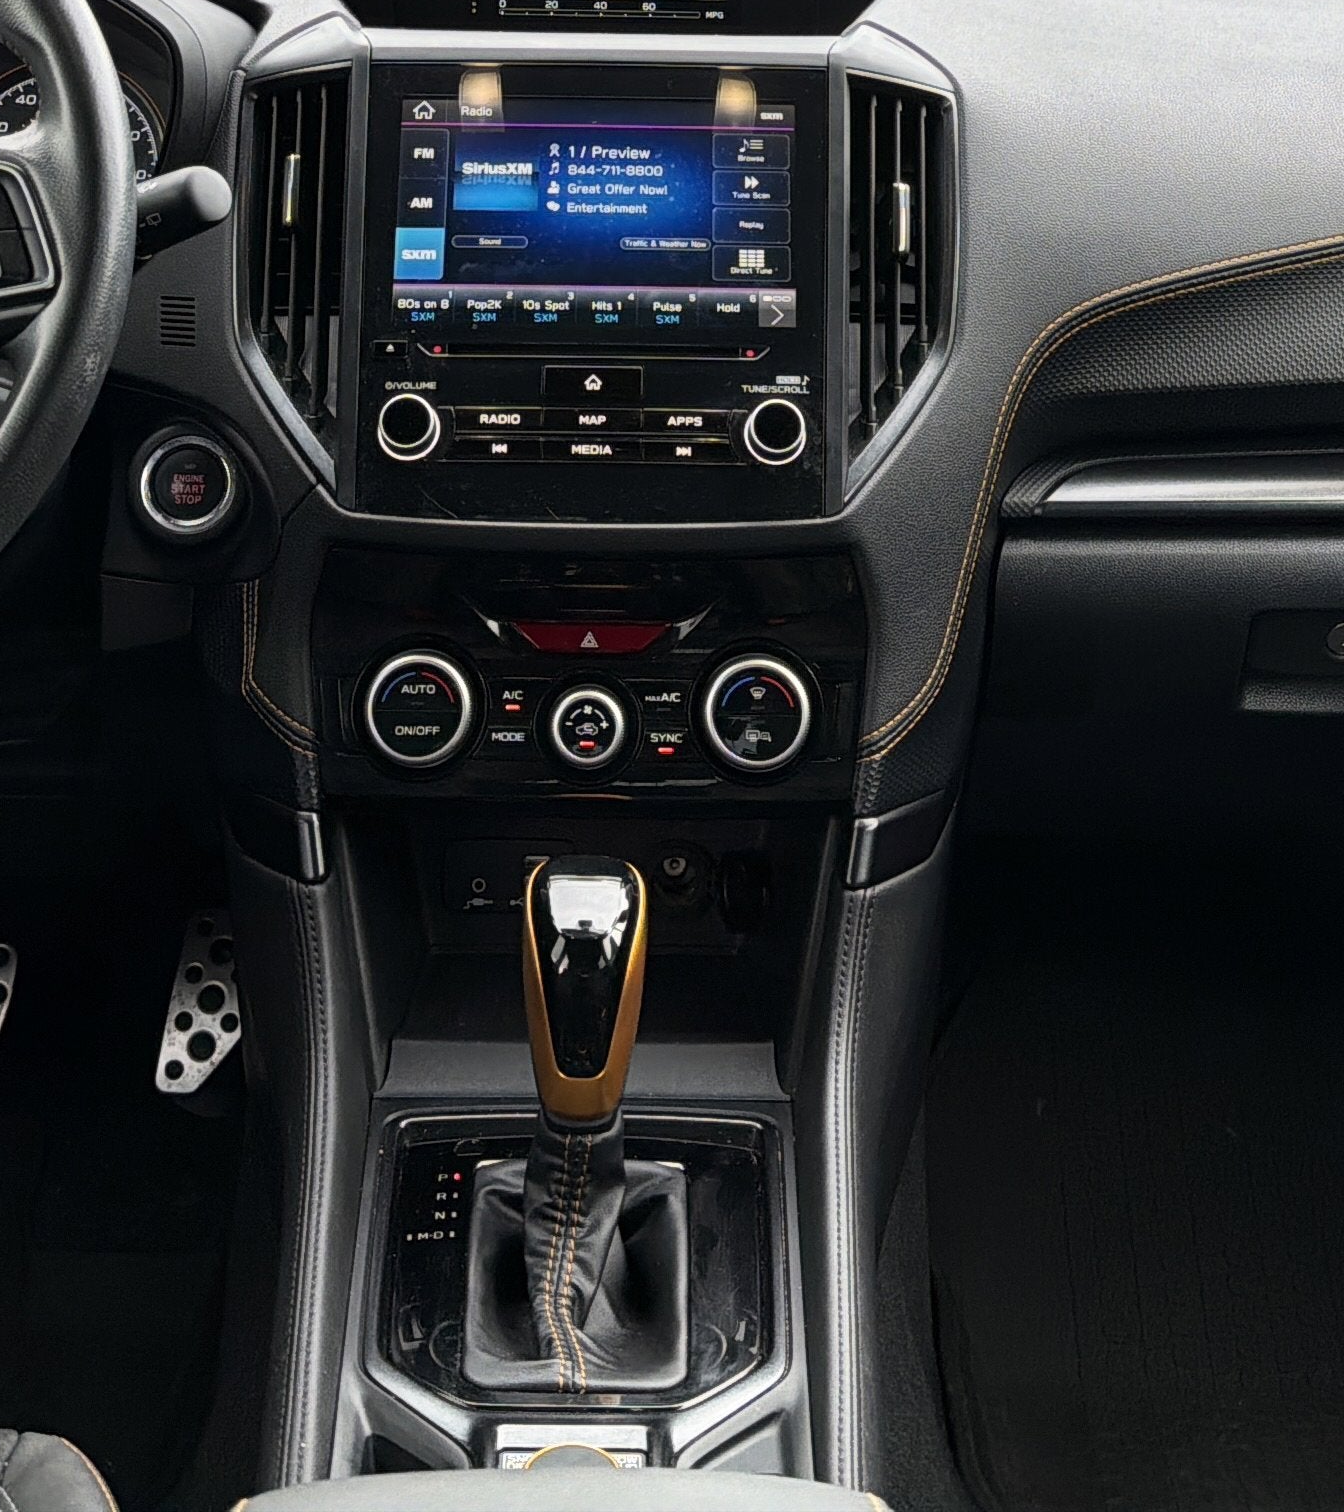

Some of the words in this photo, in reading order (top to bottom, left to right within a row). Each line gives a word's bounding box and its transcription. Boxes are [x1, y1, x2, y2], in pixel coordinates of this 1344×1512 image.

[499, 0, 507, 8] 0
[545, 0, 559, 9] 20
[593, 1, 608, 10] 40
[642, 2, 656, 11] 60
[705, 11, 724, 20] MPG
[15, 94, 37, 105] 40
[460, 105, 493, 117] Radio
[759, 112, 784, 121] sxm
[413, 148, 435, 159] FM
[568, 146, 575, 158] 1
[591, 145, 651, 159] Preview
[461, 162, 533, 175] SiriusXM
[567, 165, 664, 177] 844-711-8800
[567, 183, 601, 195] Great
[605, 183, 636, 195] Offer
[639, 184, 668, 196] Now!
[732, 191, 751, 199] Tune
[409, 198, 433, 208] AM
[567, 202, 648, 214] Entertainment
[479, 237, 502, 245] Sound
[624, 239, 648, 247] Traffic
[659, 240, 689, 248] Weather
[401, 249, 437, 260] sxm
[730, 267, 753, 275] Direct
[755, 267, 773, 275] Tune
[448, 290, 453, 299] 1
[506, 291, 513, 299] 2
[567, 291, 574, 300] 3
[627, 292, 635, 301] 4
[688, 293, 696, 302] 5
[749, 294, 757, 303] 6
[397, 299, 421, 309] 80s
[424, 301, 437, 309] on
[466, 299, 502, 310] Pop2K
[522, 300, 541, 310] 10s
[544, 300, 570, 311] Spot
[591, 301, 613, 311] Hits
[617, 301, 622, 310] 1
[653, 302, 683, 312] Pulse
[717, 303, 741, 312] Hold
[411, 312, 435, 321] SXM
[472, 313, 497, 322] SXM
[533, 313, 558, 322] SXM
[594, 314, 619, 323] SXM
[656, 315, 680, 324] SXM
[741, 384, 810, 394] TUNE/SCROLL
[479, 414, 521, 425] RADIO
[578, 415, 606, 425] MAP
[667, 416, 703, 427] APPS
[571, 445, 612, 455] MEDIA
[173, 473, 205, 483] ENGINE
[170, 483, 206, 494] START
[174, 494, 202, 504] STOP
[401, 684, 436, 694] AUTO
[502, 690, 524, 700] A/C
[661, 692, 681, 703] A/C
[395, 725, 441, 736] ON/OFF
[491, 732, 525, 742] MODE
[650, 732, 684, 744] SYNC
[437, 1173, 448, 1182] P
[436, 1192, 447, 1201] R
[434, 1211, 446, 1220] N
